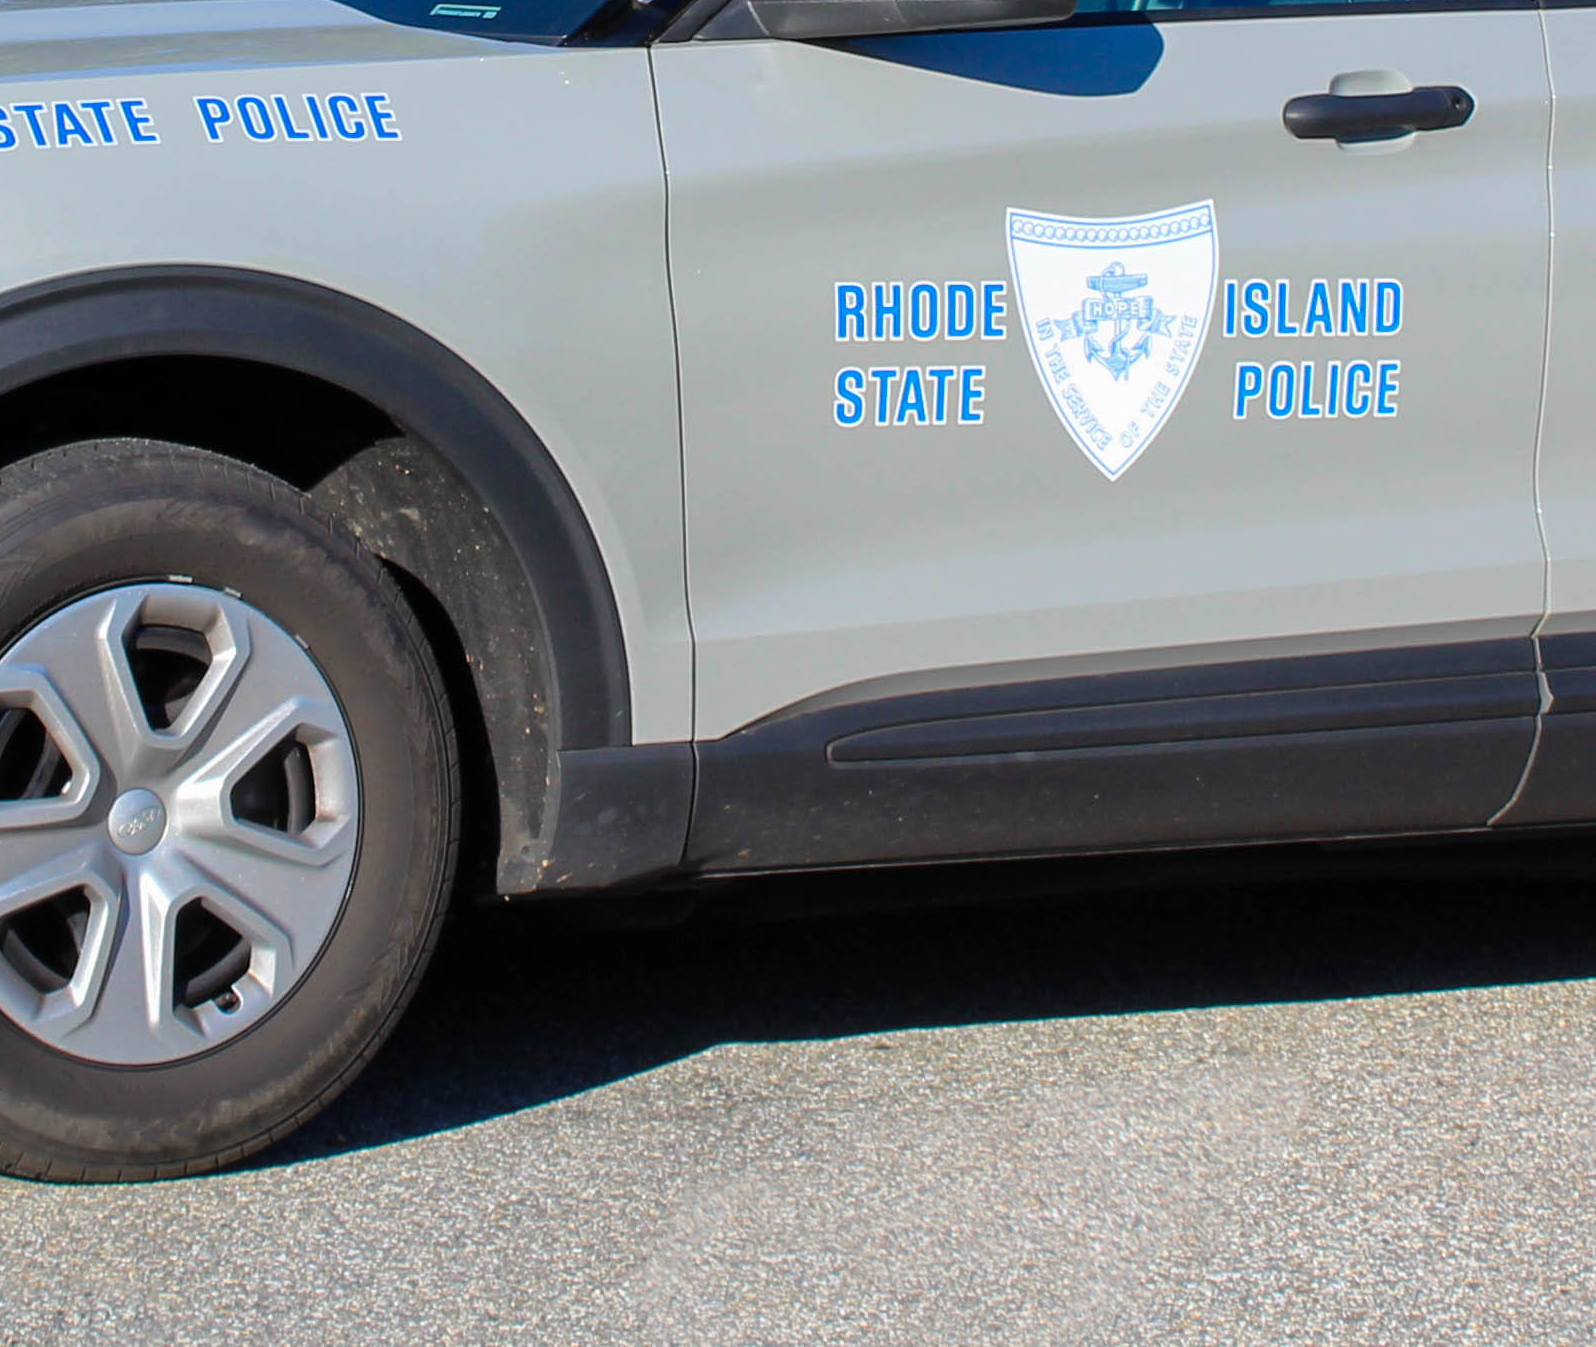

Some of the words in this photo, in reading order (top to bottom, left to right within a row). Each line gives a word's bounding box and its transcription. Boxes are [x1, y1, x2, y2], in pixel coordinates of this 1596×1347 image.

[193, 92, 403, 144] POLICE
[834, 279, 1007, 342] RHODE
[1223, 278, 1403, 338] ISLAND
[1092, 300, 1141, 318] HOPE
[833, 365, 986, 427] STATE
[1233, 359, 1401, 420] POLICE
[1036, 317, 1054, 341] IN
[1045, 343, 1071, 384] THE
[1062, 382, 1113, 451] SERVICE
[1120, 421, 1140, 448] OF
[1140, 381, 1171, 418] THE
[1166, 315, 1198, 377] STATE
